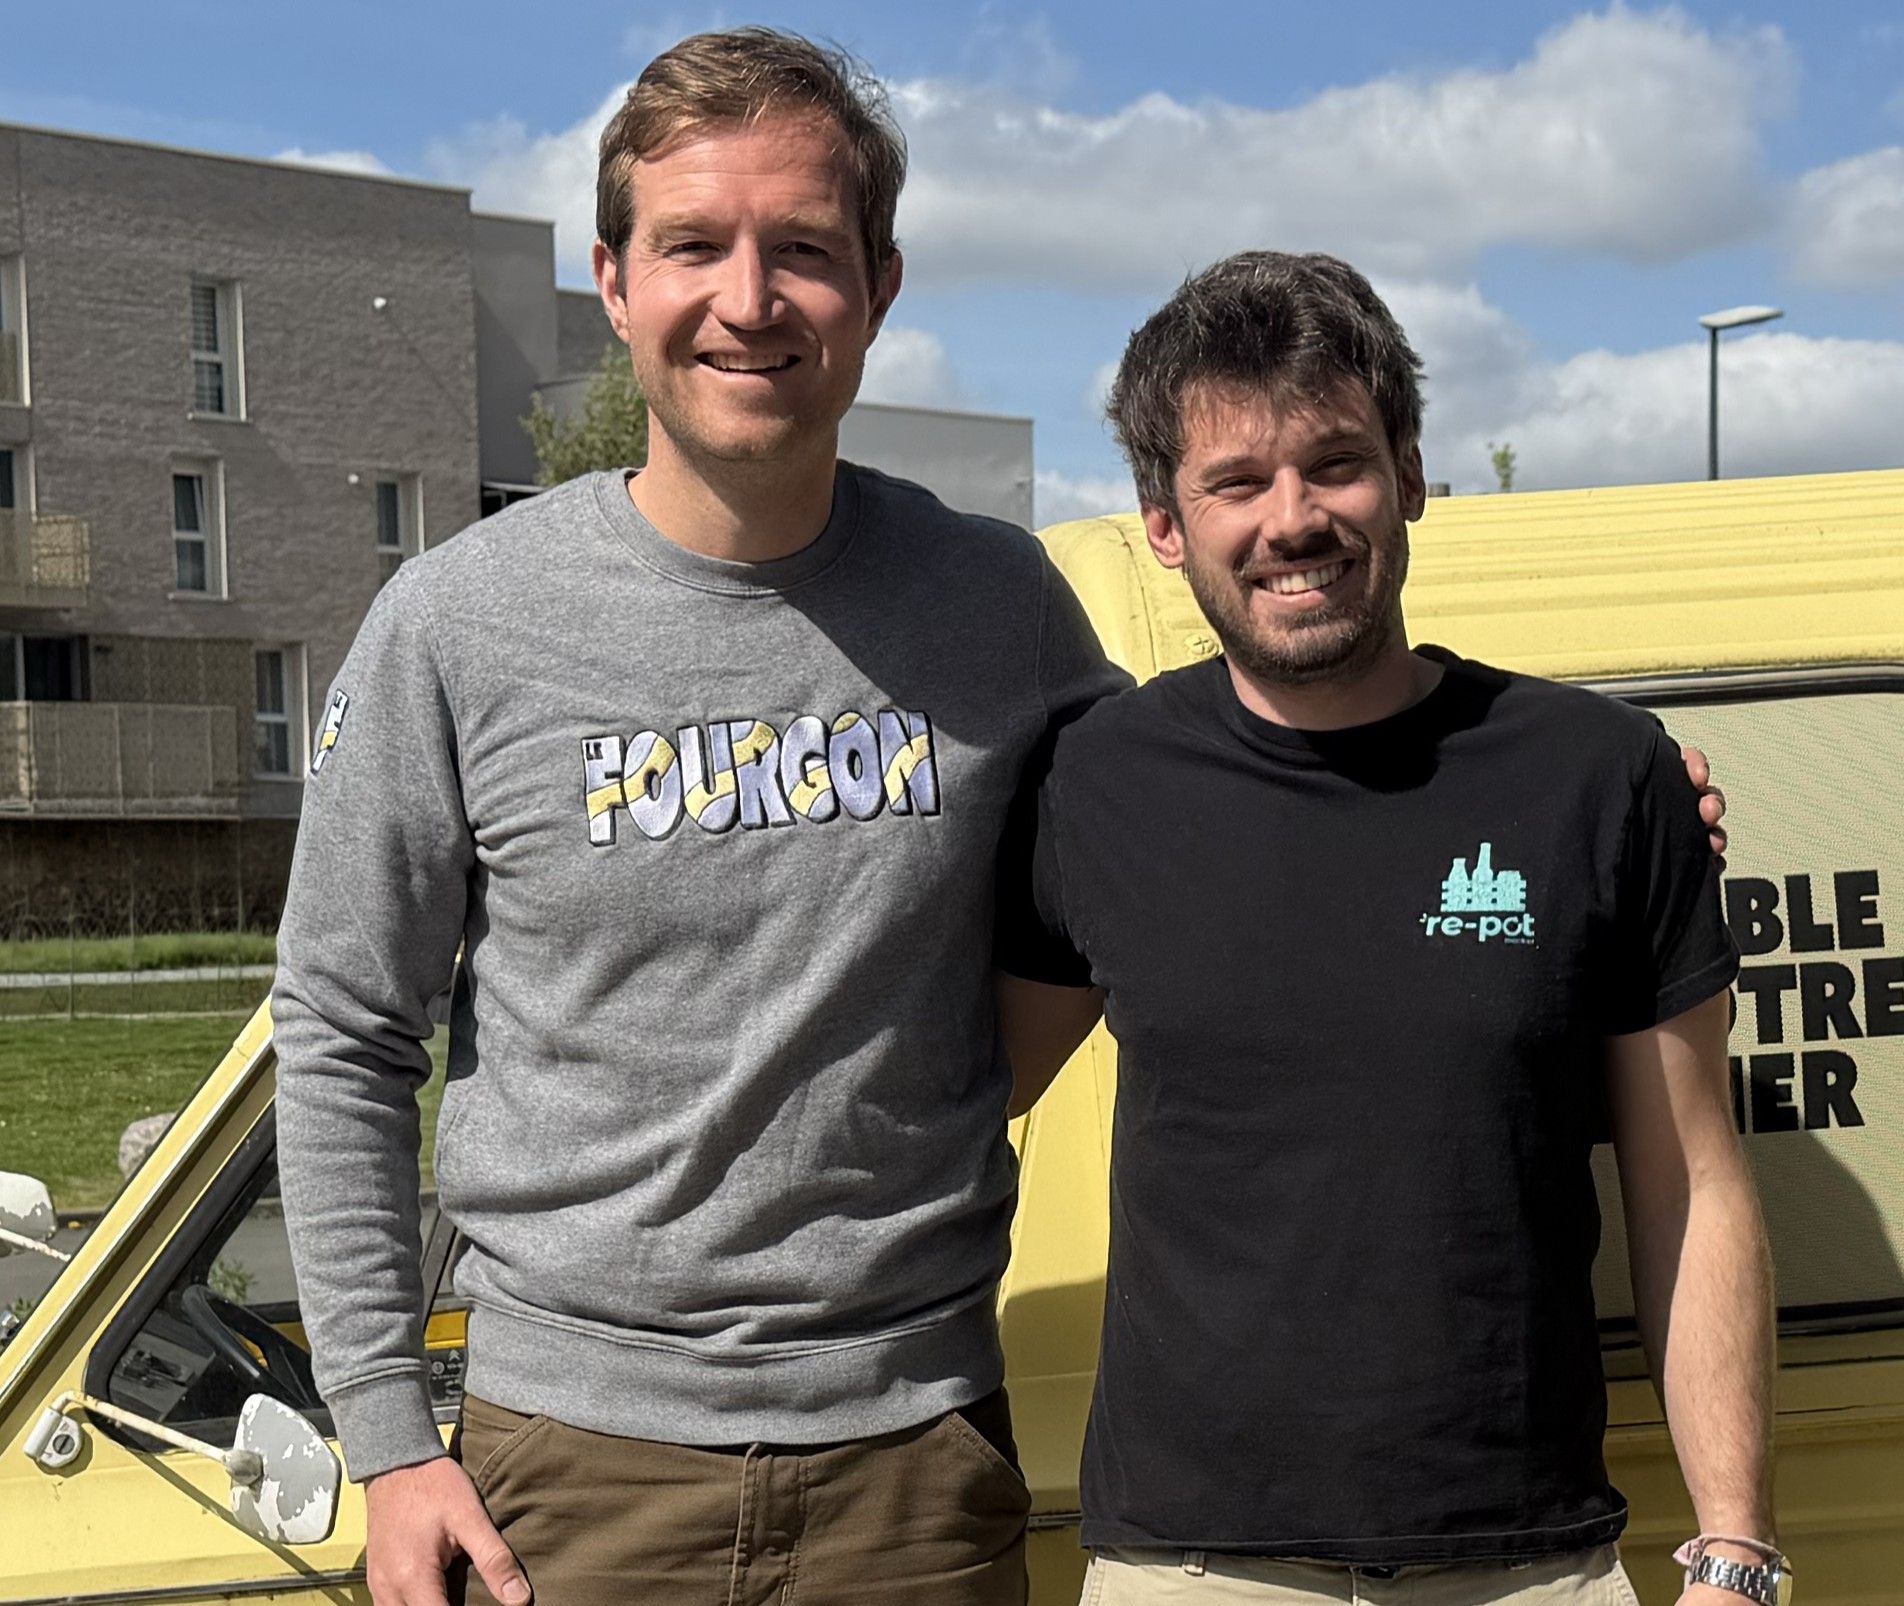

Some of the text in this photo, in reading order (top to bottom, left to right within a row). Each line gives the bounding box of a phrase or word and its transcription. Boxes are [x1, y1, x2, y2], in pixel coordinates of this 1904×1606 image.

[581, 709, 942, 847] FOURGON
[1425, 913, 1535, 942] re-pot
[1725, 870, 1886, 956] BLE
